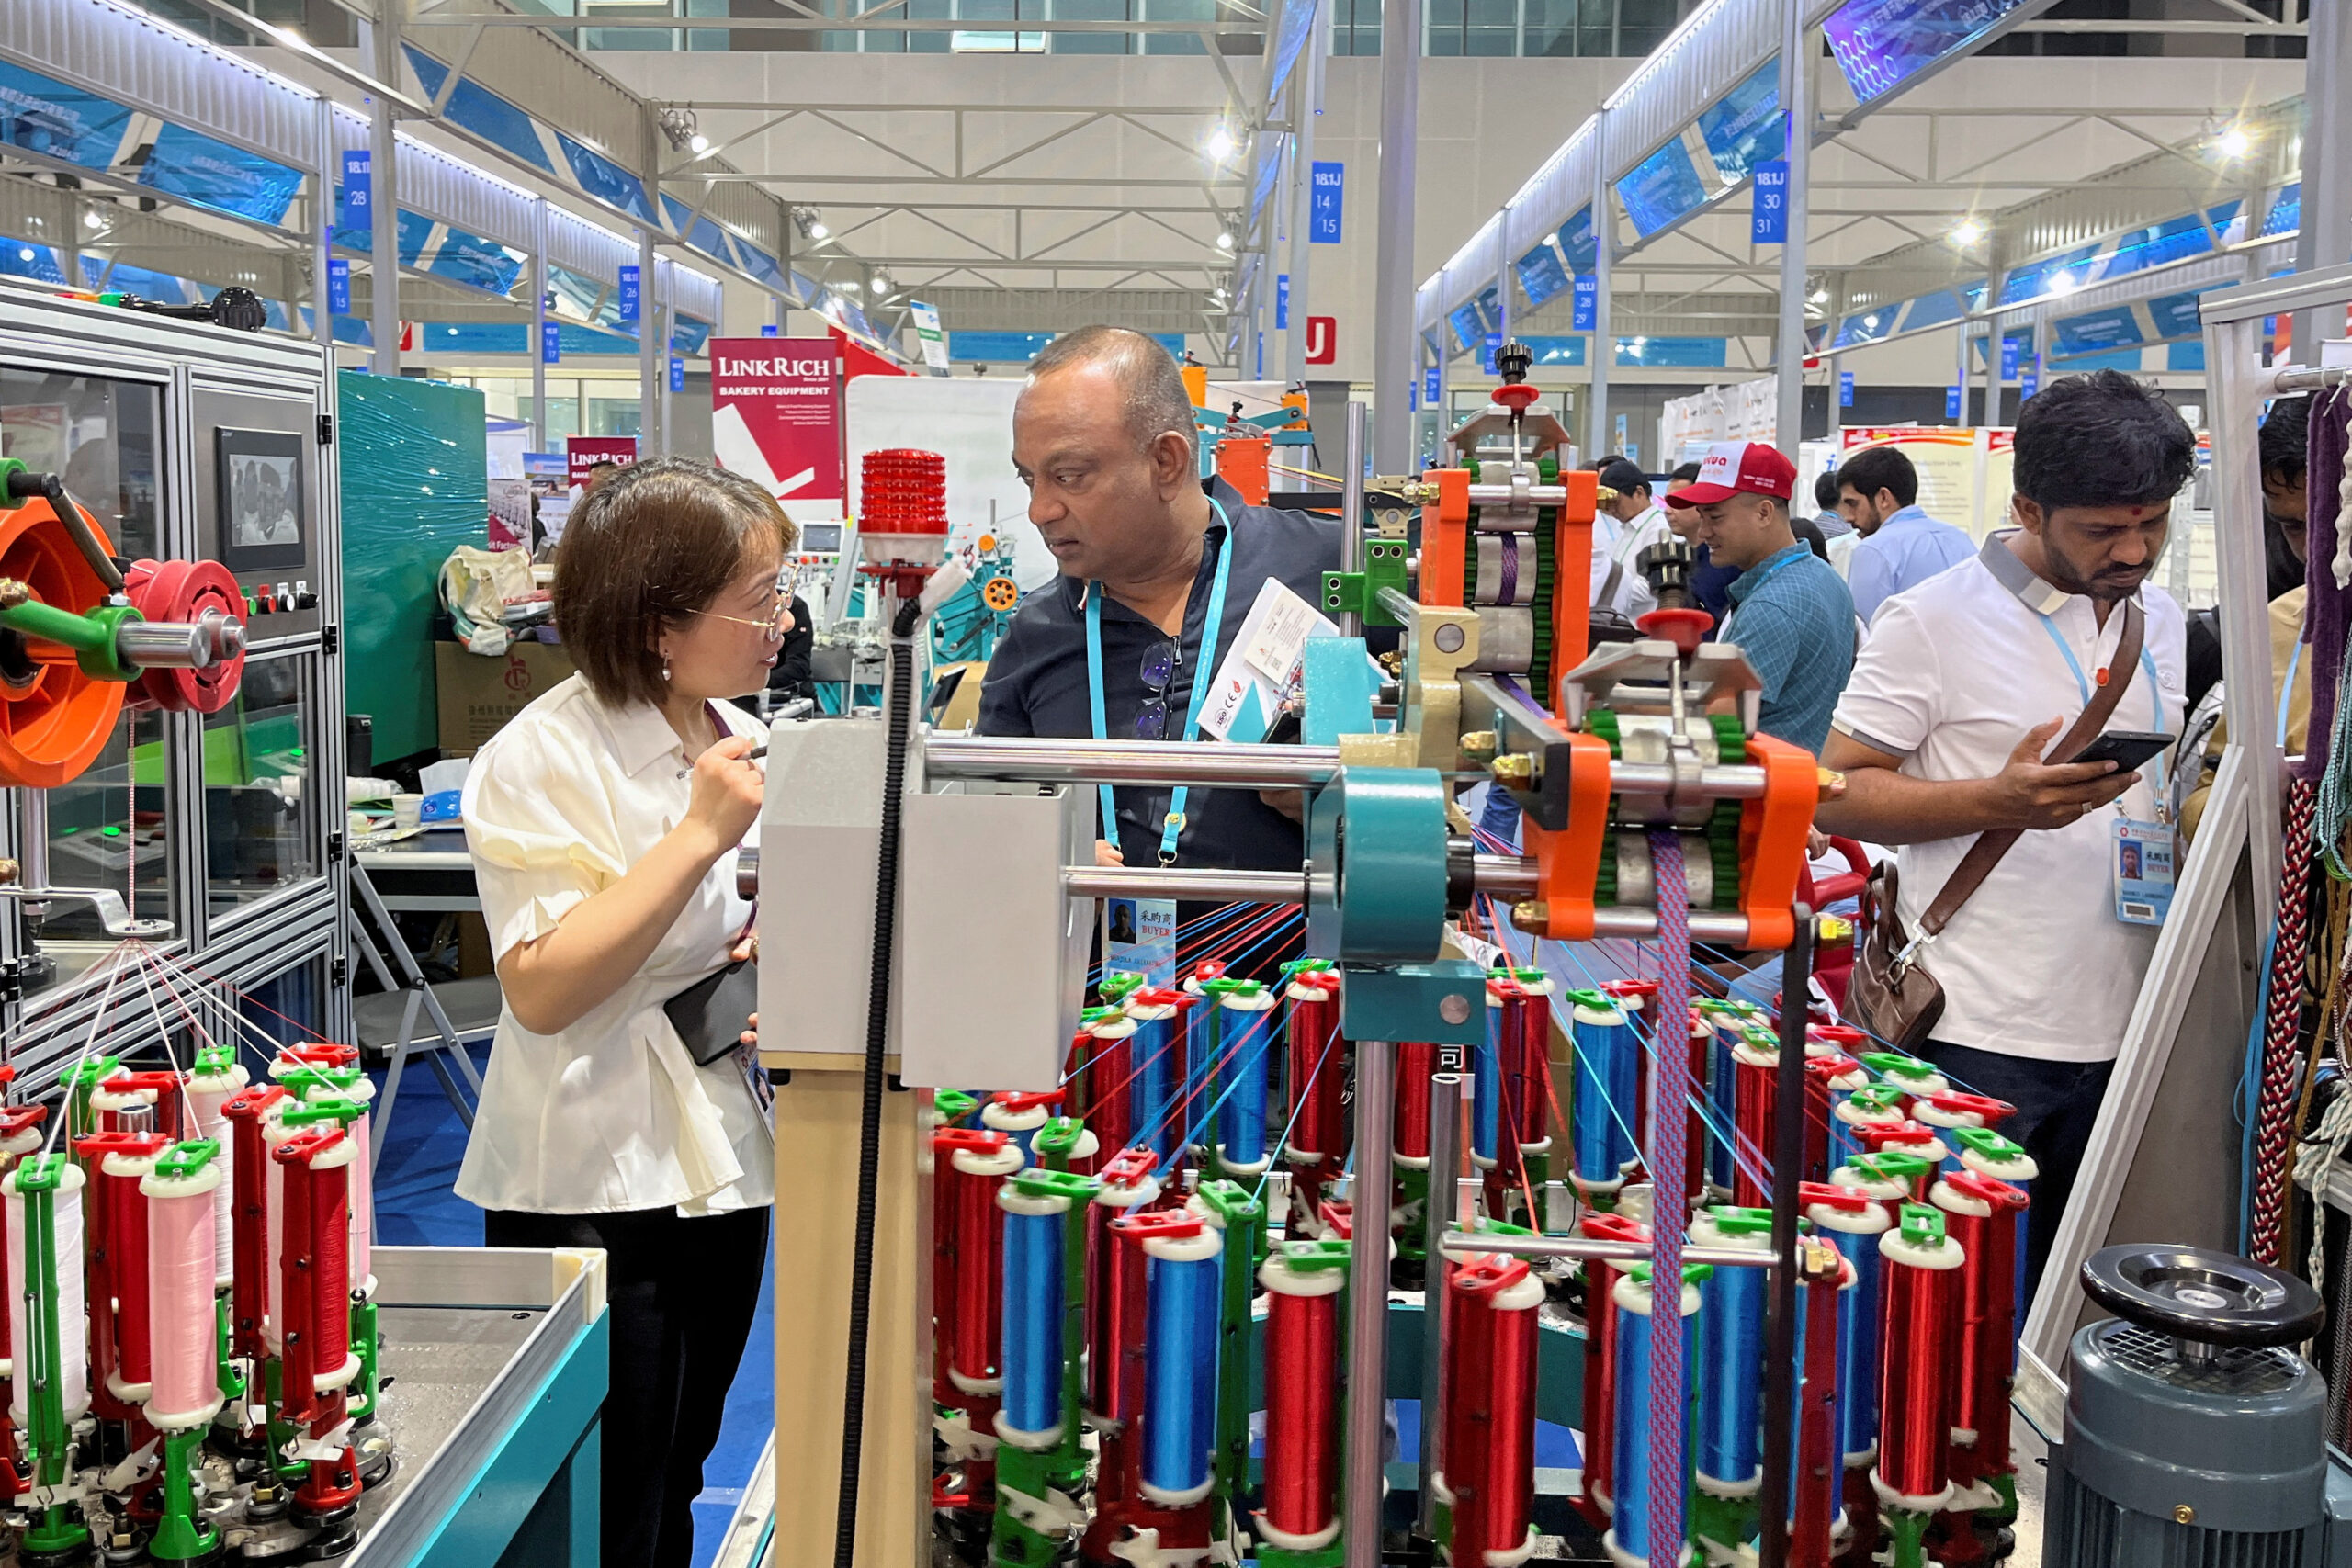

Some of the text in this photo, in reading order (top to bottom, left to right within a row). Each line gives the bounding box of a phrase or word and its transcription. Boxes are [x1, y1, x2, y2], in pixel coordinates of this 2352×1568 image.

[1314, 173, 1341, 186] 18.1J
[1756, 172, 1785, 186] 18.1J
[351, 190, 367, 205] 28
[1317, 194, 1330, 209] 14
[1764, 194, 1781, 209] 30
[1323, 219, 1336, 233] 15
[1756, 219, 1770, 233] 31
[627, 287, 638, 298] 26
[336, 297, 346, 309] 15
[623, 303, 633, 314] 27
[1580, 297, 1592, 308] 28
[1576, 313, 1587, 324] 29
[1306, 322, 1325, 358] J
[719, 387, 830, 396] BAKERY EQUIPMENT
[1217, 711, 1227, 725] ISO
[1140, 910, 1171, 925] 采购商
[1142, 925, 1170, 936] BUYER
